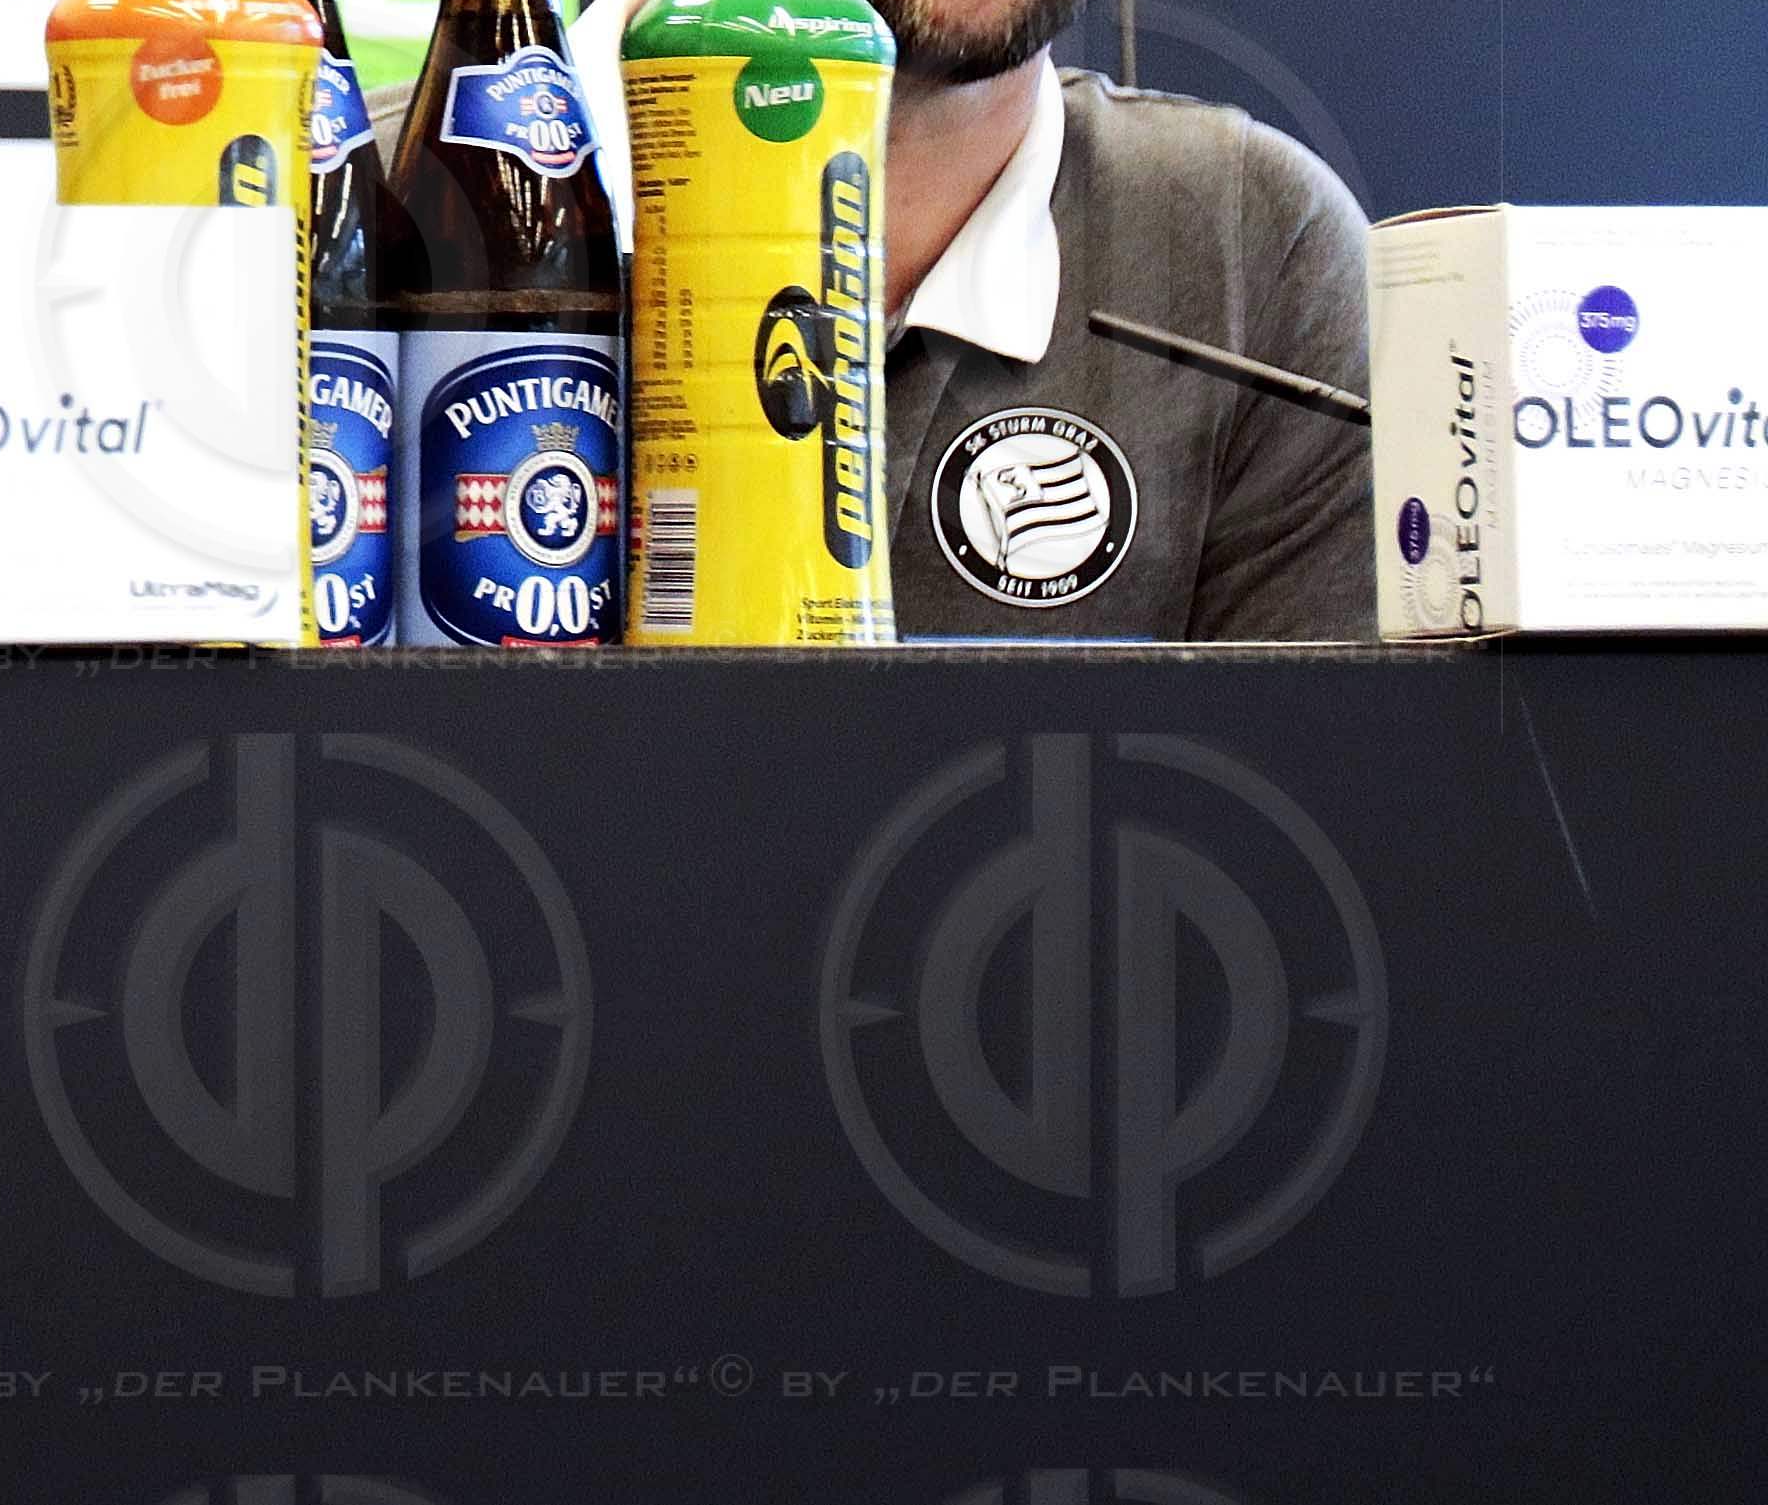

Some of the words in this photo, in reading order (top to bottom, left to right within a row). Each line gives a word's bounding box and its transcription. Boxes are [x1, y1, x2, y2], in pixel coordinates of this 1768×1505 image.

[742, 82, 814, 109] Neu
[826, 178, 872, 542] peeroton
[1512, 387, 1768, 450] OLEOvit
[1450, 354, 1484, 631] OLEOvital
